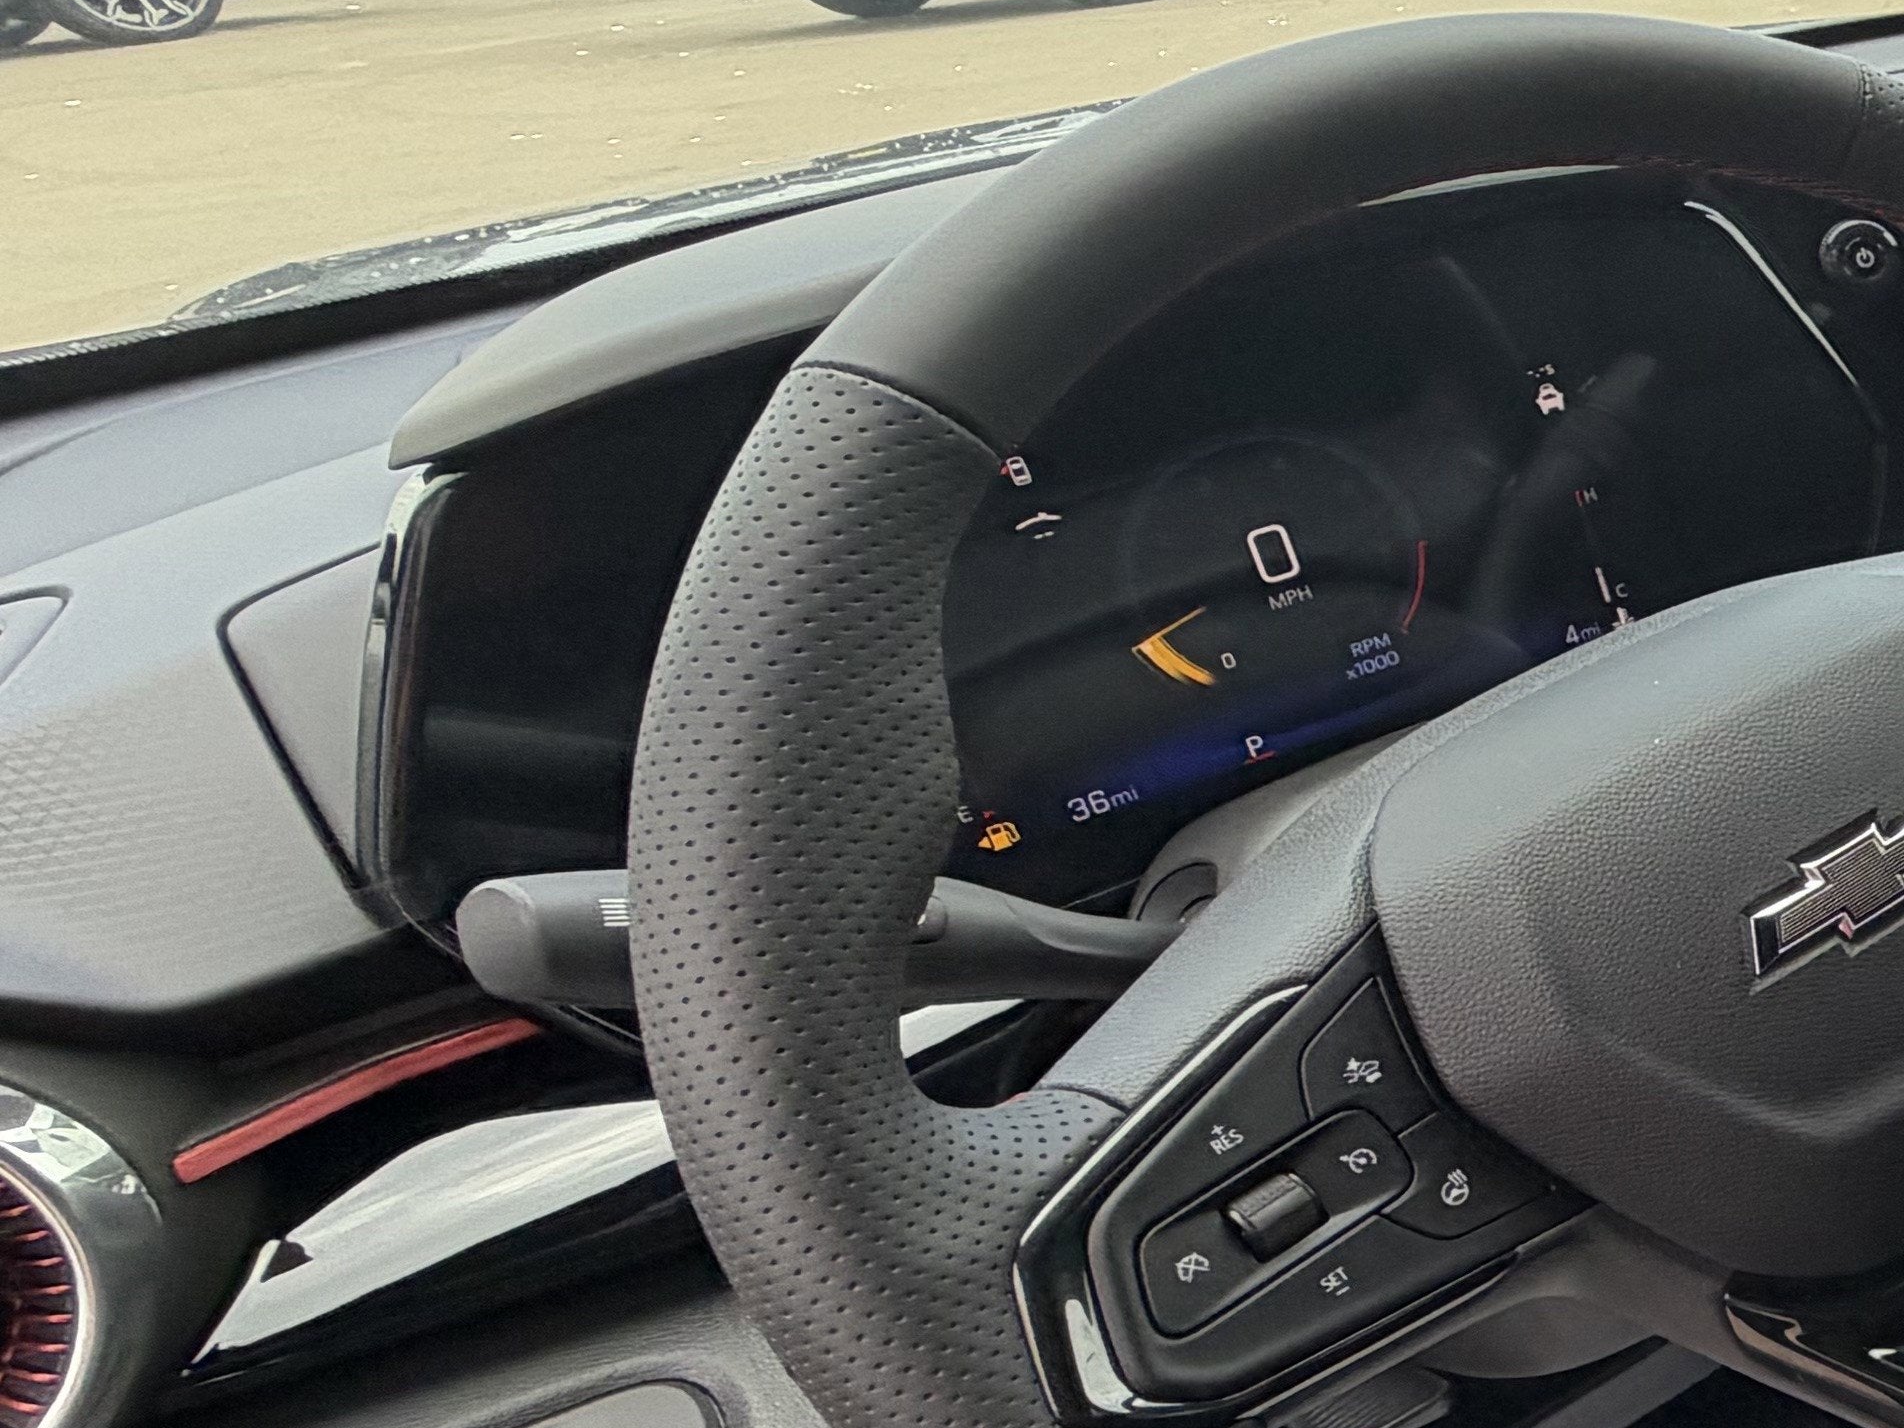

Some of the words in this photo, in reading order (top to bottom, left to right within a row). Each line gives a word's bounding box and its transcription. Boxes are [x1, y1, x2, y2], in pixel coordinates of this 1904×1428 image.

[1247, 524, 1301, 583] 0
[1268, 584, 1314, 610] MPH
[1615, 582, 1629, 598] C
[1349, 632, 1392, 657] RPM
[1346, 650, 1400, 680] x1000
[1245, 735, 1264, 758] P
[957, 805, 974, 823] E
[1210, 1128, 1244, 1155] RES
[1320, 1266, 1349, 1293] SET
